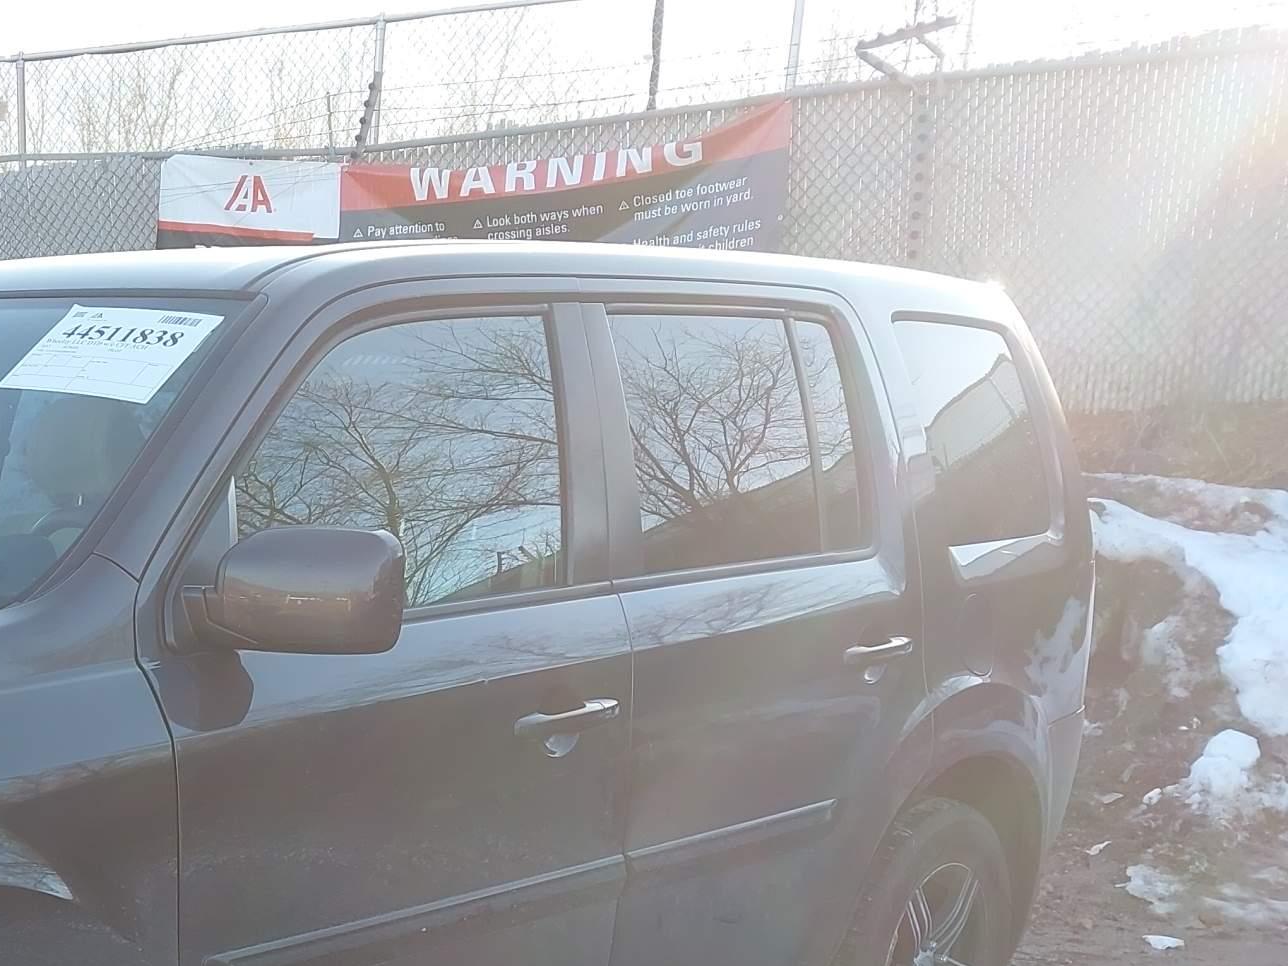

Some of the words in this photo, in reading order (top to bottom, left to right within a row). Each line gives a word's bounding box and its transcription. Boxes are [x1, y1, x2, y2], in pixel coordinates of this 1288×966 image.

[410, 141, 703, 202] WARNING
[633, 189, 672, 207] Closed
[675, 188, 693, 199] toe
[696, 177, 748, 195] footwear
[634, 207, 662, 221] must
[664, 204, 678, 216] be
[680, 200, 711, 213] worn
[713, 195, 723, 207] in
[726, 188, 754, 207] yard.
[486, 213, 511, 227] Look
[514, 211, 538, 225] both
[540, 210, 569, 222] ways
[572, 204, 604, 217] when
[367, 226, 387, 238] Pay
[389, 221, 433, 235] attention
[435, 222, 445, 231] to
[487, 228, 532, 240] crossing
[536, 223, 571, 236] aisles.
[673, 230, 693, 245] and
[696, 225, 730, 241] safety
[732, 219, 761, 233] rules
[62, 324, 184, 348] 44511838
